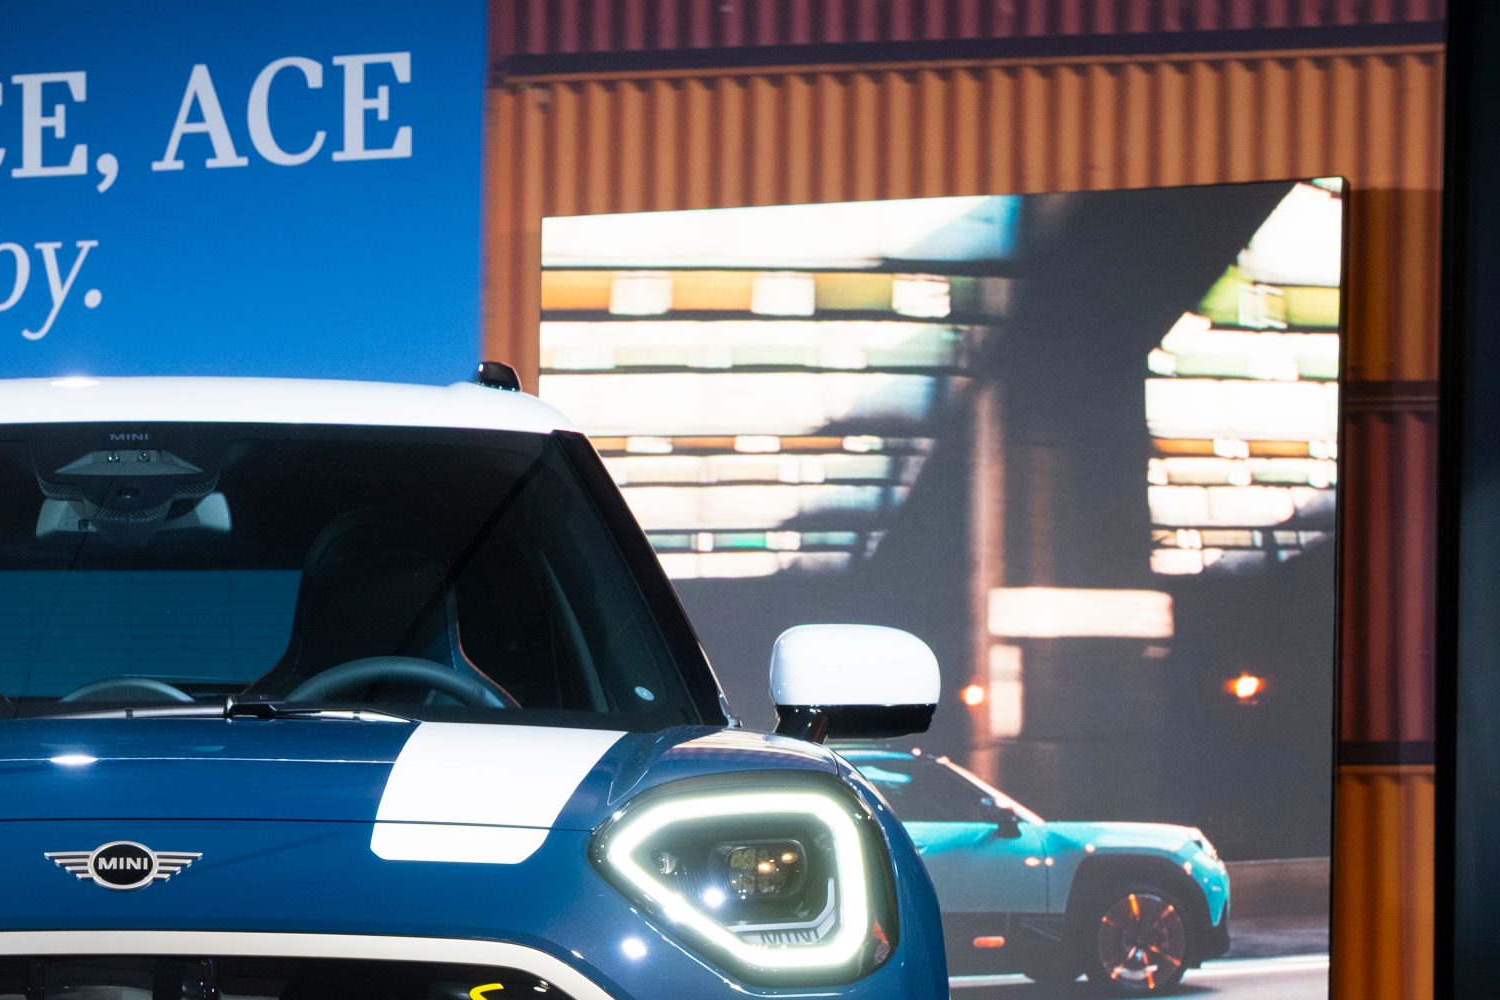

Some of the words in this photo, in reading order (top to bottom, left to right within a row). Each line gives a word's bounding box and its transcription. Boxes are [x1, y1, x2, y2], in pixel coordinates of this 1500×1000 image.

[151, 51, 413, 171] ACE
[110, 433, 149, 441] MINI
[97, 855, 149, 873] MINI
[761, 927, 819, 944] MINI
